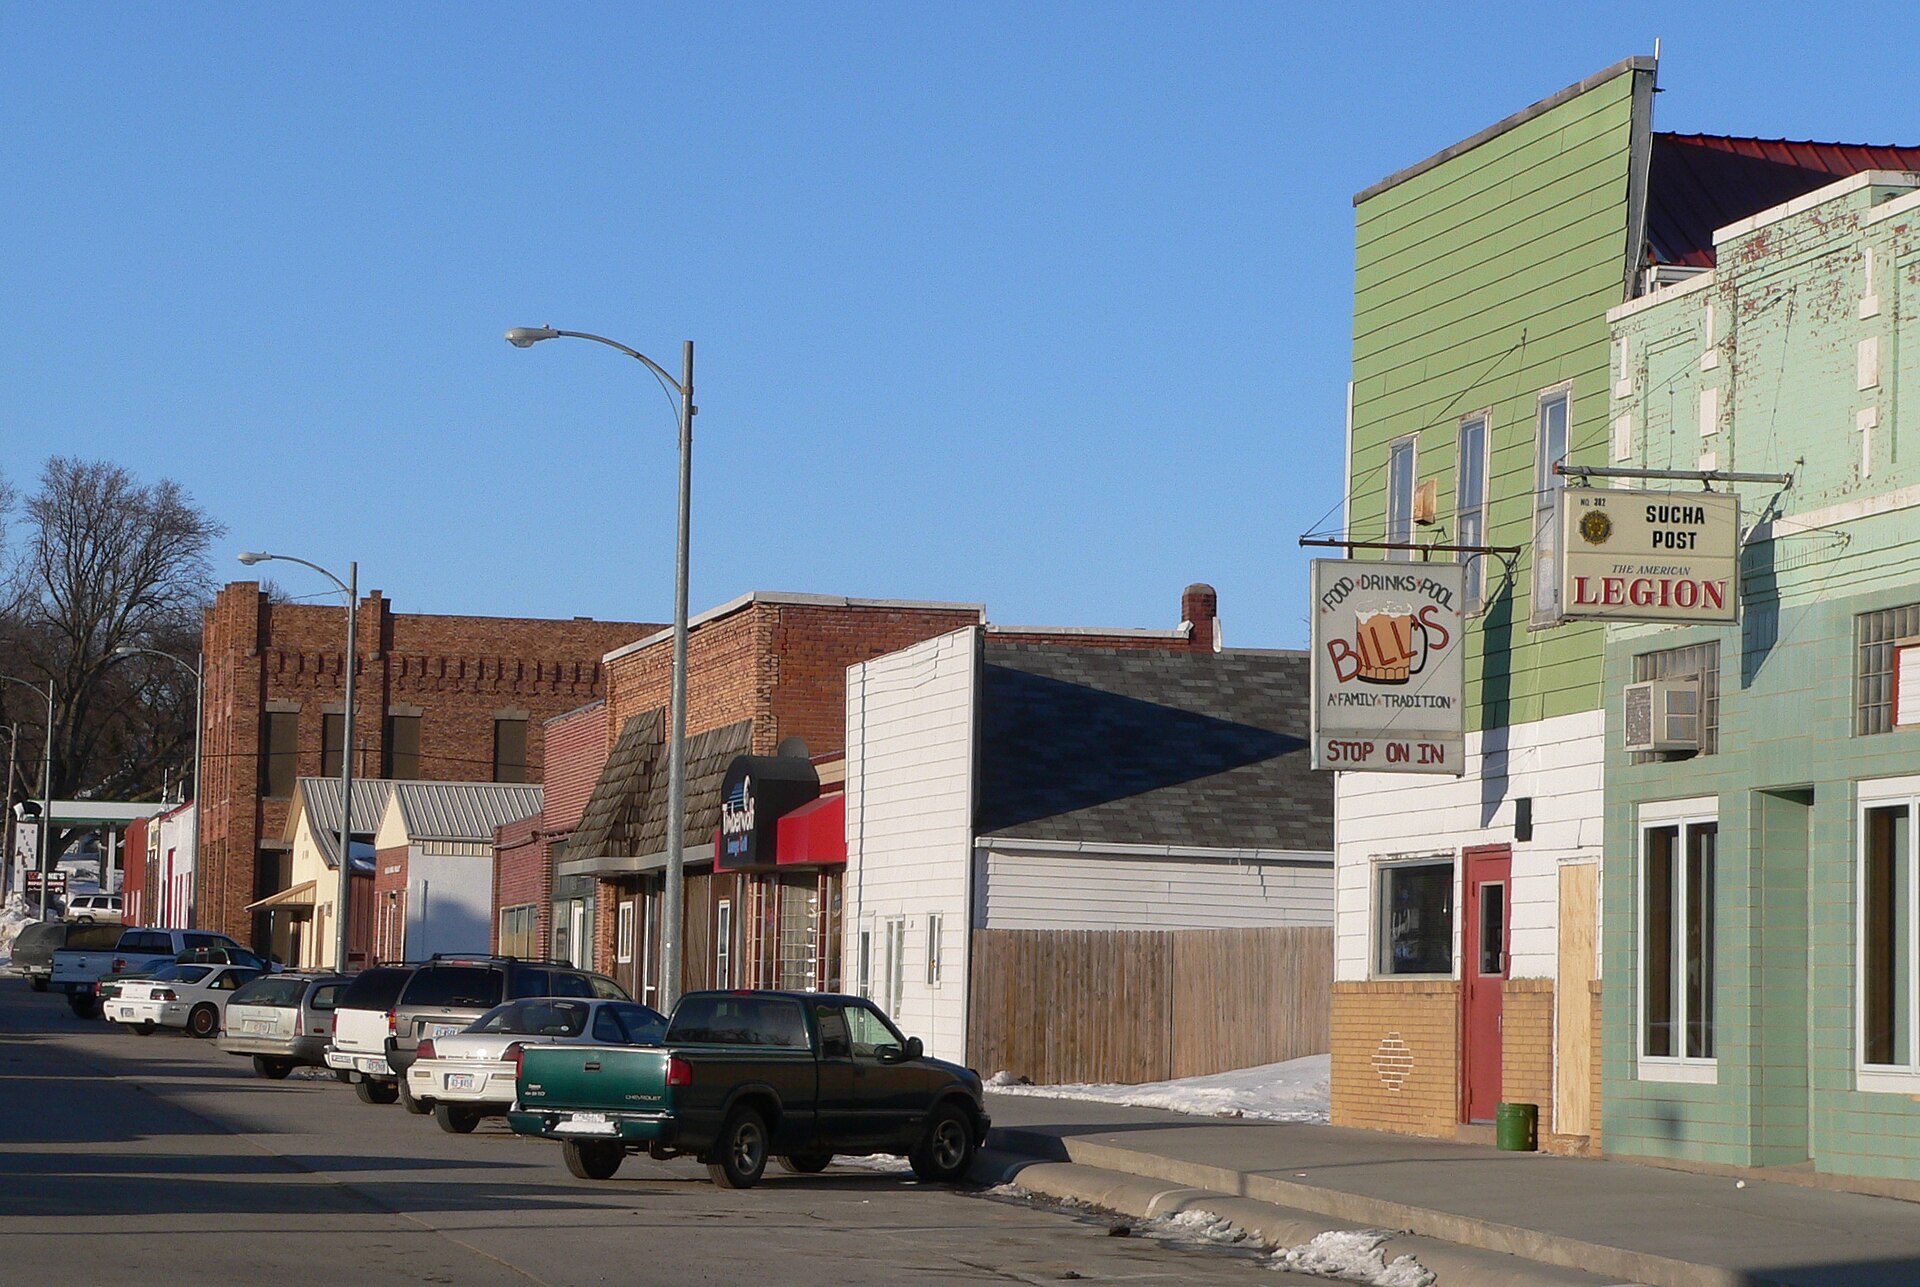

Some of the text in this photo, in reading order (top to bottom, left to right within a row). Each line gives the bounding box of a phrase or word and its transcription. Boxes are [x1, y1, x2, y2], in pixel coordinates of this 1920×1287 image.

[1645, 505, 1705, 525] SUCHA
[1652, 531, 1697, 550] POST
[1612, 564, 1691, 576] THE AMERICAN
[1322, 574, 1454, 612] FOOD DRINKS POOL
[1573, 576, 1727, 609] LEGION
[1327, 605, 1450, 683] BILL'S
[1327, 693, 1451, 709] A FAMILY TRADITION
[1326, 740, 1445, 764] STOP ON IN
